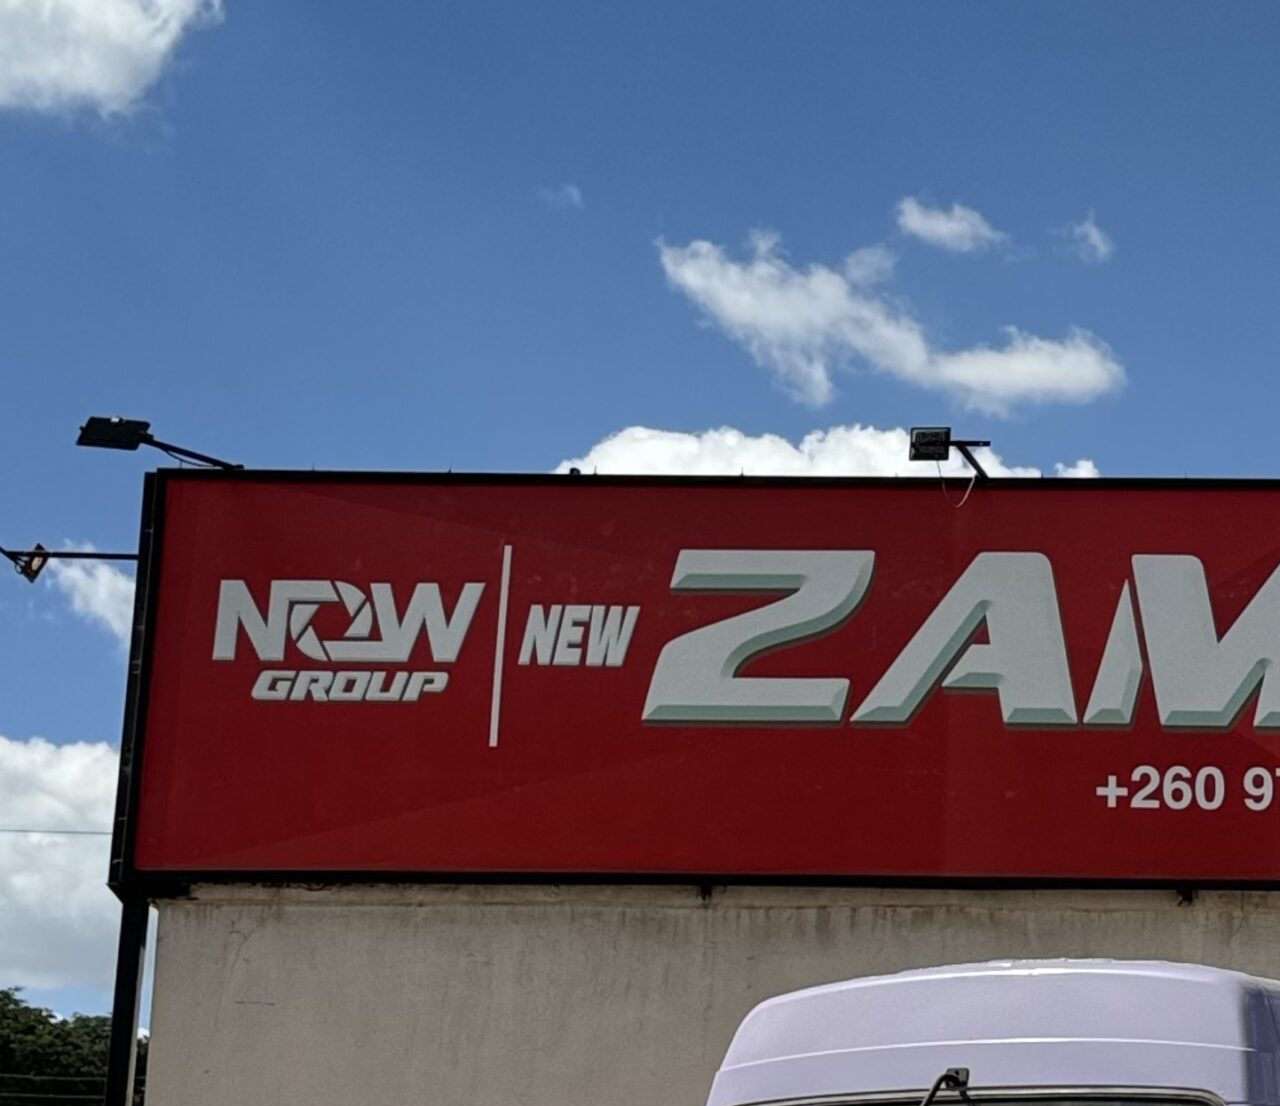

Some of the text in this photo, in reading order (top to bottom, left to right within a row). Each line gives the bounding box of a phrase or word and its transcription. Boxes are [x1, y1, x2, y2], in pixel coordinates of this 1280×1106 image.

[517, 604, 641, 667] NEW
[250, 670, 449, 702] GROUP
[1095, 765, 1225, 811] +260
